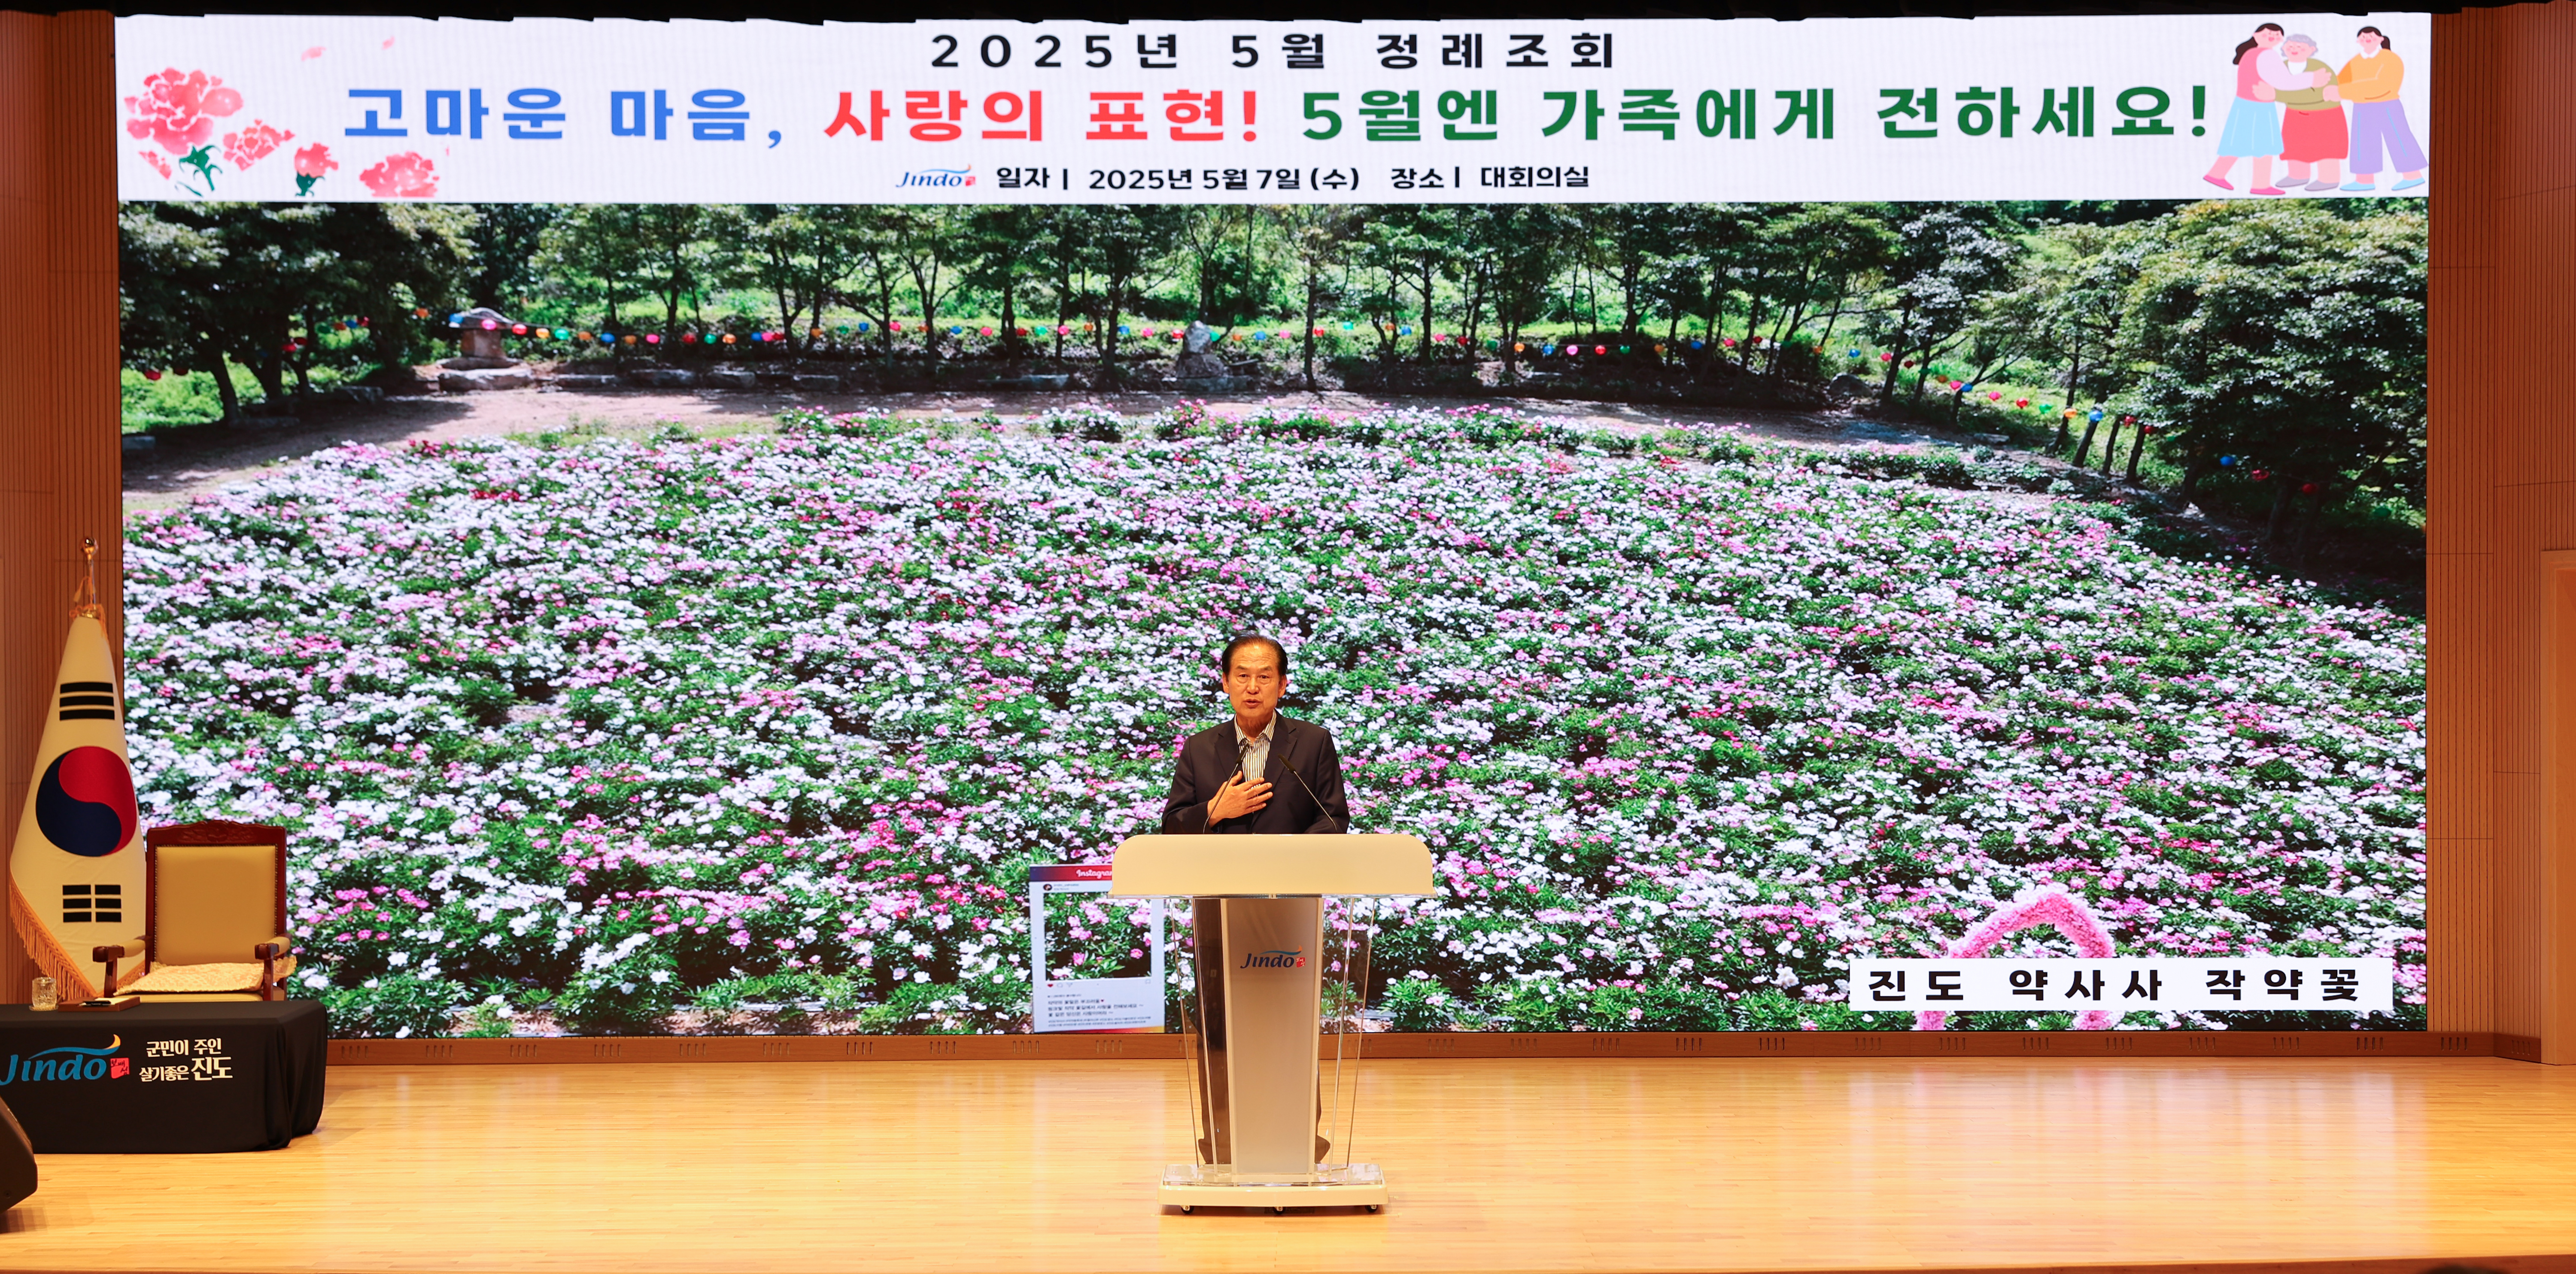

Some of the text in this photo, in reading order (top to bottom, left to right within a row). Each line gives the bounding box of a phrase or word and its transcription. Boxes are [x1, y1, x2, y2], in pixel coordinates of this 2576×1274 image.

[932, 33, 1612, 69] 2025년 5월 정례조회
[345, 85, 2206, 148] 고마운 마음, 사랑의 표현! 5월엔 가족에게 전하세요!
[896, 172, 962, 187] Jindo
[997, 167, 1050, 188] 일자
[1089, 169, 1192, 189] 2025년
[1203, 169, 1247, 190] 5월
[1257, 169, 1300, 189] 7일
[1311, 168, 1359, 191] (수)
[1391, 168, 1444, 189] 장소
[1481, 166, 1589, 188] 대회의실
[1240, 953, 1294, 969] Jindo
[1869, 969, 2359, 1001] 진도 약사사 작약꽃
[146, 1038, 222, 1057] 군민이 주인
[0, 1054, 106, 1086] Jindo
[139, 1057, 233, 1082] 살기좋은 진도
